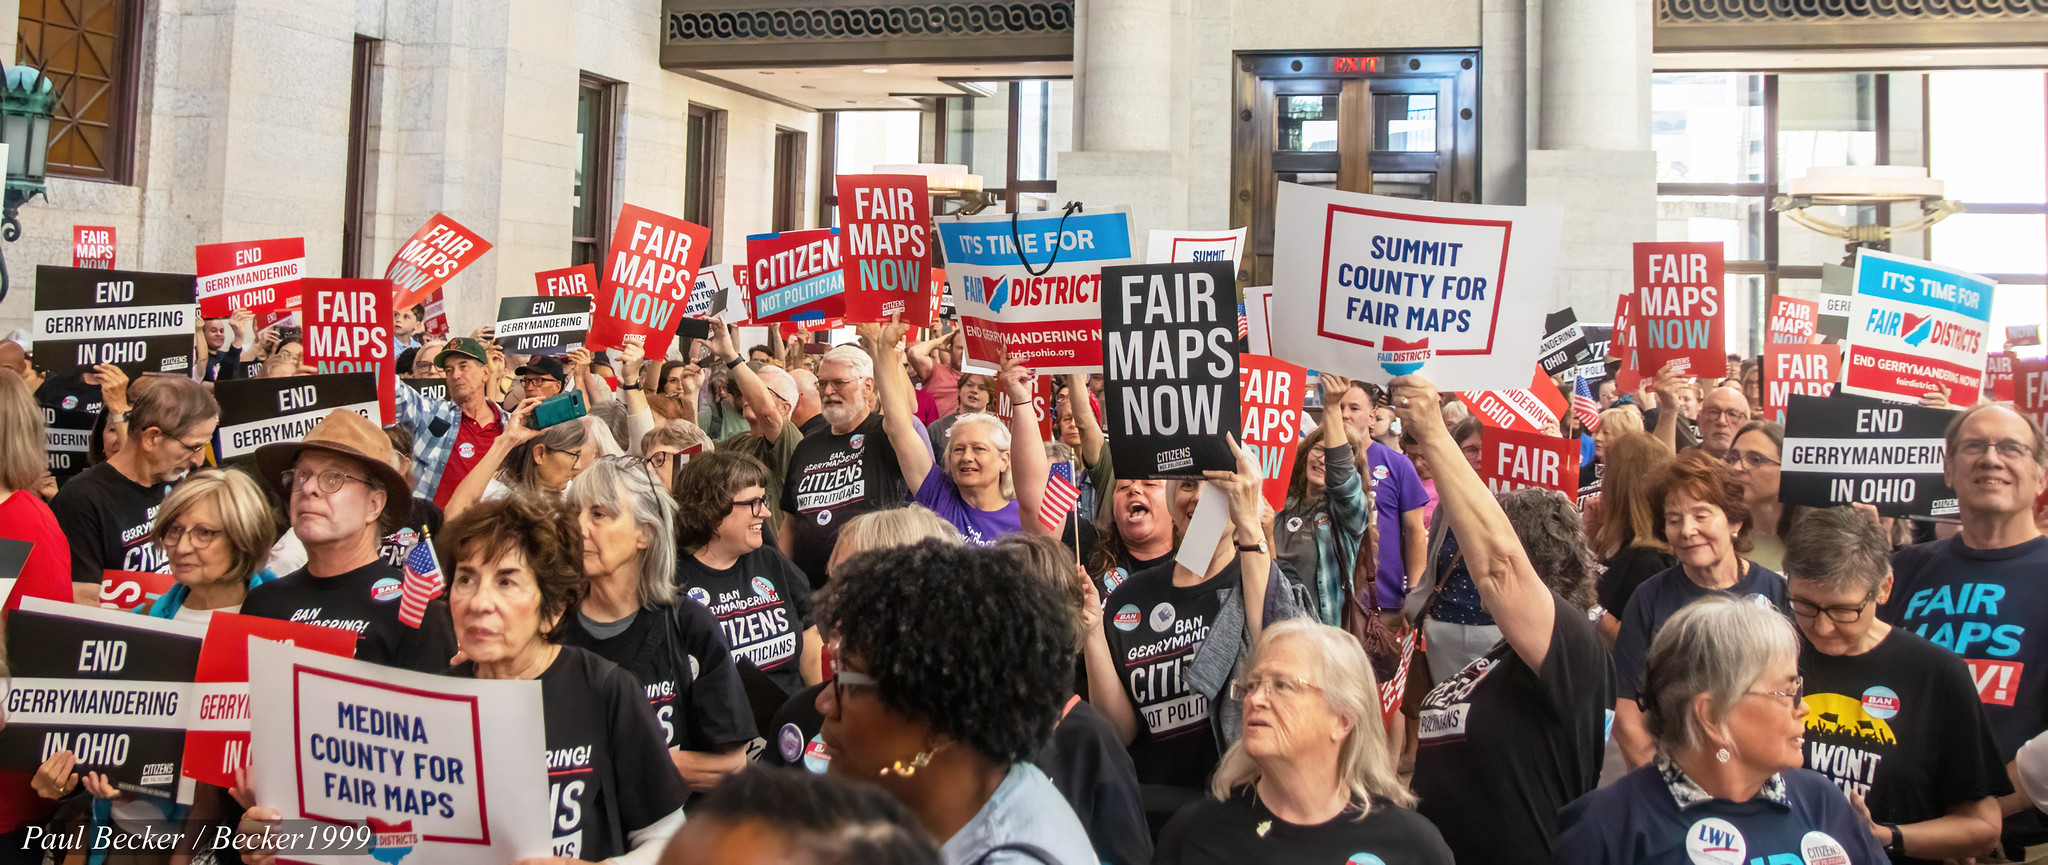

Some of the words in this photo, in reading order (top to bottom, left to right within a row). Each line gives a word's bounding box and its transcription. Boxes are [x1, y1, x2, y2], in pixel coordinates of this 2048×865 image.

[1334, 56, 1379, 72] EXIT
[855, 187, 915, 220] FAIR
[77, 244, 113, 259] MAPS
[81, 230, 109, 245] FAIR
[423, 223, 474, 259] FAIR
[630, 220, 692, 266] FAIR
[848, 223, 926, 257] MAPS
[959, 235, 983, 255] IT'S
[1044, 229, 1094, 252] FOR
[1370, 235, 1463, 267] SUMMIT
[236, 247, 261, 266] END
[398, 239, 459, 278] MAPS
[755, 236, 843, 291] CITIZEN
[1192, 249, 1225, 262] SUMMIT
[1648, 254, 1708, 284] FAIR
[205, 263, 298, 292] GERRYMANDERING
[387, 260, 434, 293] NOW
[547, 274, 588, 297] FAIR
[611, 251, 690, 301] MAPS
[859, 259, 920, 293] NOW
[1338, 263, 1435, 298] COUNTY
[1441, 276, 1487, 301] FOR
[96, 281, 134, 303] END
[228, 295, 240, 311] IN
[245, 288, 275, 308] OHIO
[761, 295, 780, 313] NOT
[963, 275, 984, 305] FAIR
[1011, 274, 1101, 307] DISTRICT
[1121, 272, 1217, 325] FAIR
[1640, 286, 1718, 317] MAPS
[1881, 271, 1915, 294] IT'S
[1920, 278, 1956, 303] TIME
[1959, 288, 1980, 310] FOR
[318, 291, 377, 323] FAIR
[532, 301, 555, 315] END
[609, 287, 675, 331] NOW
[882, 300, 905, 310] CITIZENS
[1347, 297, 1399, 328] FAIR
[1405, 306, 1472, 333] MAPS
[1778, 301, 1811, 320] FAIR
[46, 310, 183, 333] GERRYMANDERING
[501, 316, 582, 333] GERRYMANDERING
[966, 326, 982, 339] END
[982, 328, 1088, 345] GERRYMANDERING
[1648, 319, 1711, 349] NOW
[1771, 316, 1813, 337] MAPS
[1865, 308, 1901, 336] FAIR
[1930, 320, 1982, 354] DISTRICTS
[78, 344, 96, 365] IN
[102, 341, 147, 364] OHIO
[310, 326, 387, 358] MAPS
[518, 337, 529, 350] IN
[533, 334, 559, 348] OHIO
[1108, 327, 1234, 381] MAPS
[1377, 352, 1393, 362] FAIR
[1393, 350, 1431, 362] DISTRICTS
[161, 355, 187, 365] CITIZENS
[1543, 350, 1568, 371] OHIO
[1777, 353, 1828, 380] FAIR
[1853, 353, 1875, 368] END
[1877, 358, 1960, 384] GERRYMANDERING
[278, 385, 317, 411] END
[1122, 384, 1223, 436] NOW
[1480, 395, 1516, 430] OHIO
[1856, 409, 1903, 433] END
[829, 451, 845, 461] BAN
[1157, 447, 1191, 463] CITIZENS
[1498, 442, 1560, 486] FAIR
[798, 459, 863, 493] CITIZENS
[799, 495, 811, 507] NOT
[813, 484, 860, 505] POLITICIANS
[1830, 479, 1854, 503] IN
[1860, 478, 1915, 503] OHIO
[719, 589, 740, 604] BAN
[1904, 583, 2006, 620] FAIR
[290, 607, 322, 622] BAN
[1175, 615, 1203, 634] BAN
[78, 640, 128, 672] END
[8, 688, 178, 716] GERRYMANDERING
[1868, 696, 1893, 705] BAN
[337, 701, 428, 744] MEDINA
[75, 733, 130, 766] OHIO
[223, 740, 242, 773] IN
[311, 733, 404, 776] COUNTY
[414, 753, 464, 784] FOR
[1810, 741, 1882, 784] WON'T
[143, 763, 174, 775] CITIZENS
[324, 772, 377, 807] FAIR
[384, 784, 455, 818] MAPS
[379, 834, 418, 845] DISTRICTS
[1698, 824, 1736, 849] LWV
